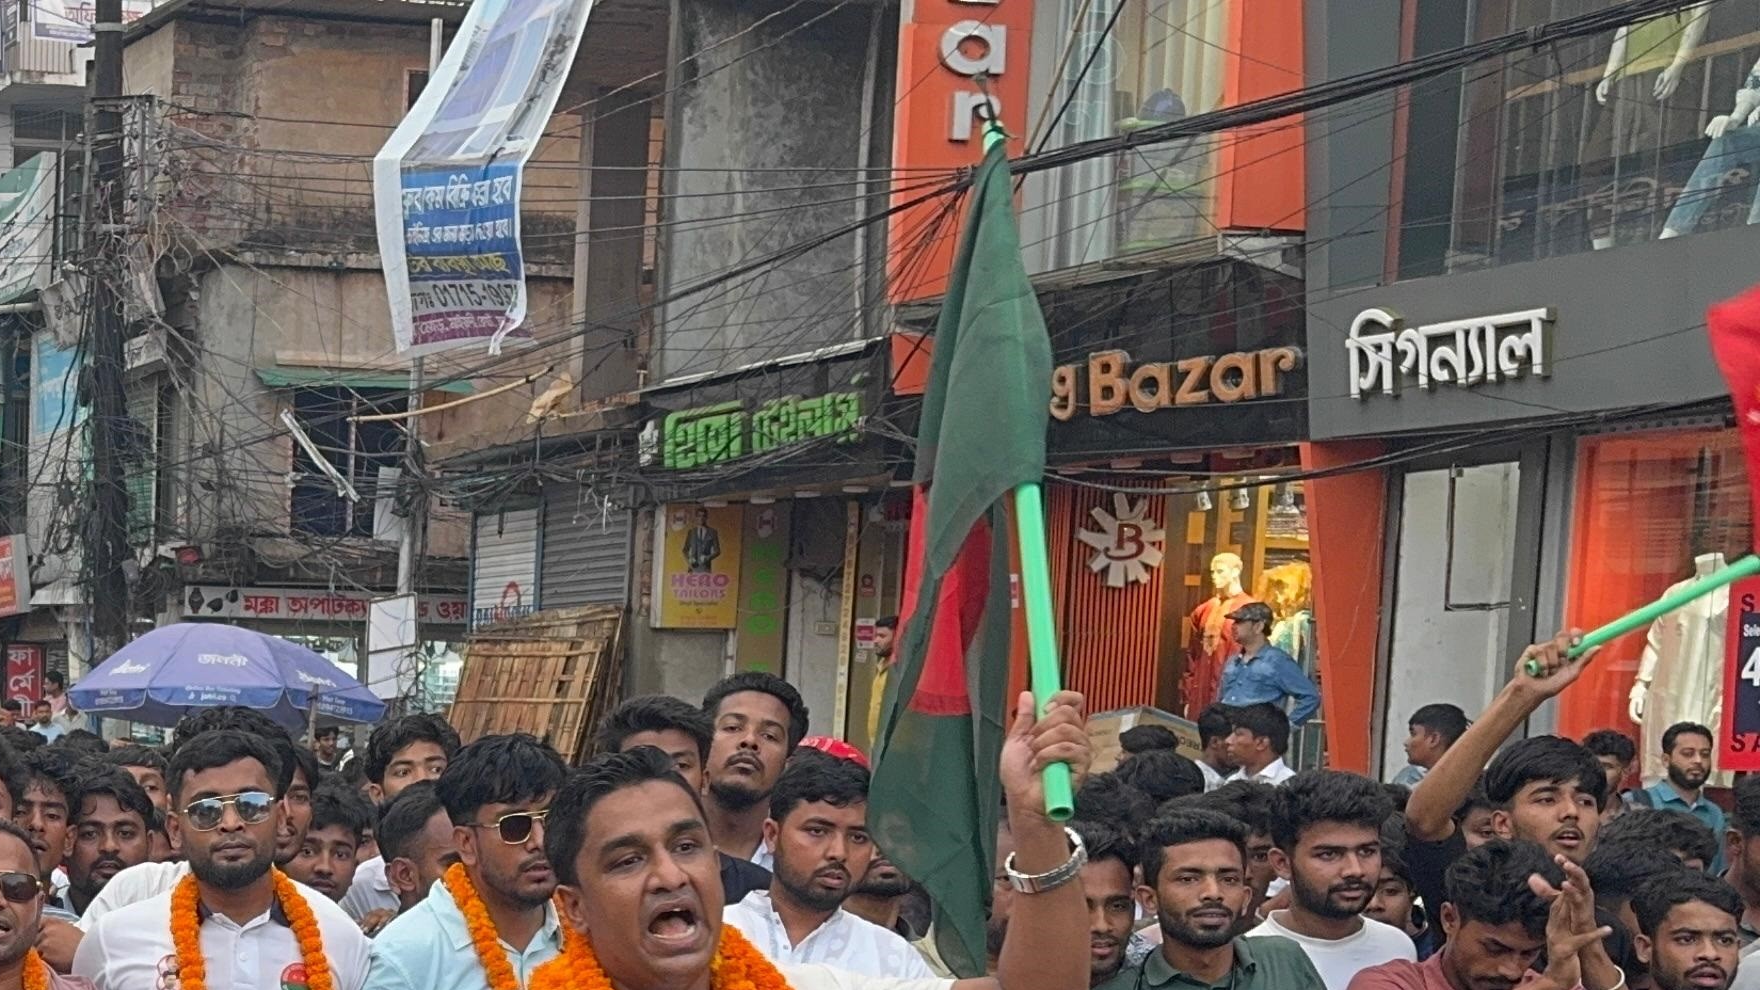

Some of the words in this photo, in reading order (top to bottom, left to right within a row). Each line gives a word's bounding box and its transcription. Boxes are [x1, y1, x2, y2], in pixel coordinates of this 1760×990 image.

[938, 0, 1007, 143] ar
[1345, 308, 1551, 399] সিগন্যাল
[1088, 346, 1302, 417] Bazar
[671, 573, 730, 587] HERO
[672, 588, 727, 599] TAILORS
[243, 594, 280, 616] মক্কা
[287, 593, 368, 616] অপটিক্য
[437, 600, 468, 619] ওয়া
